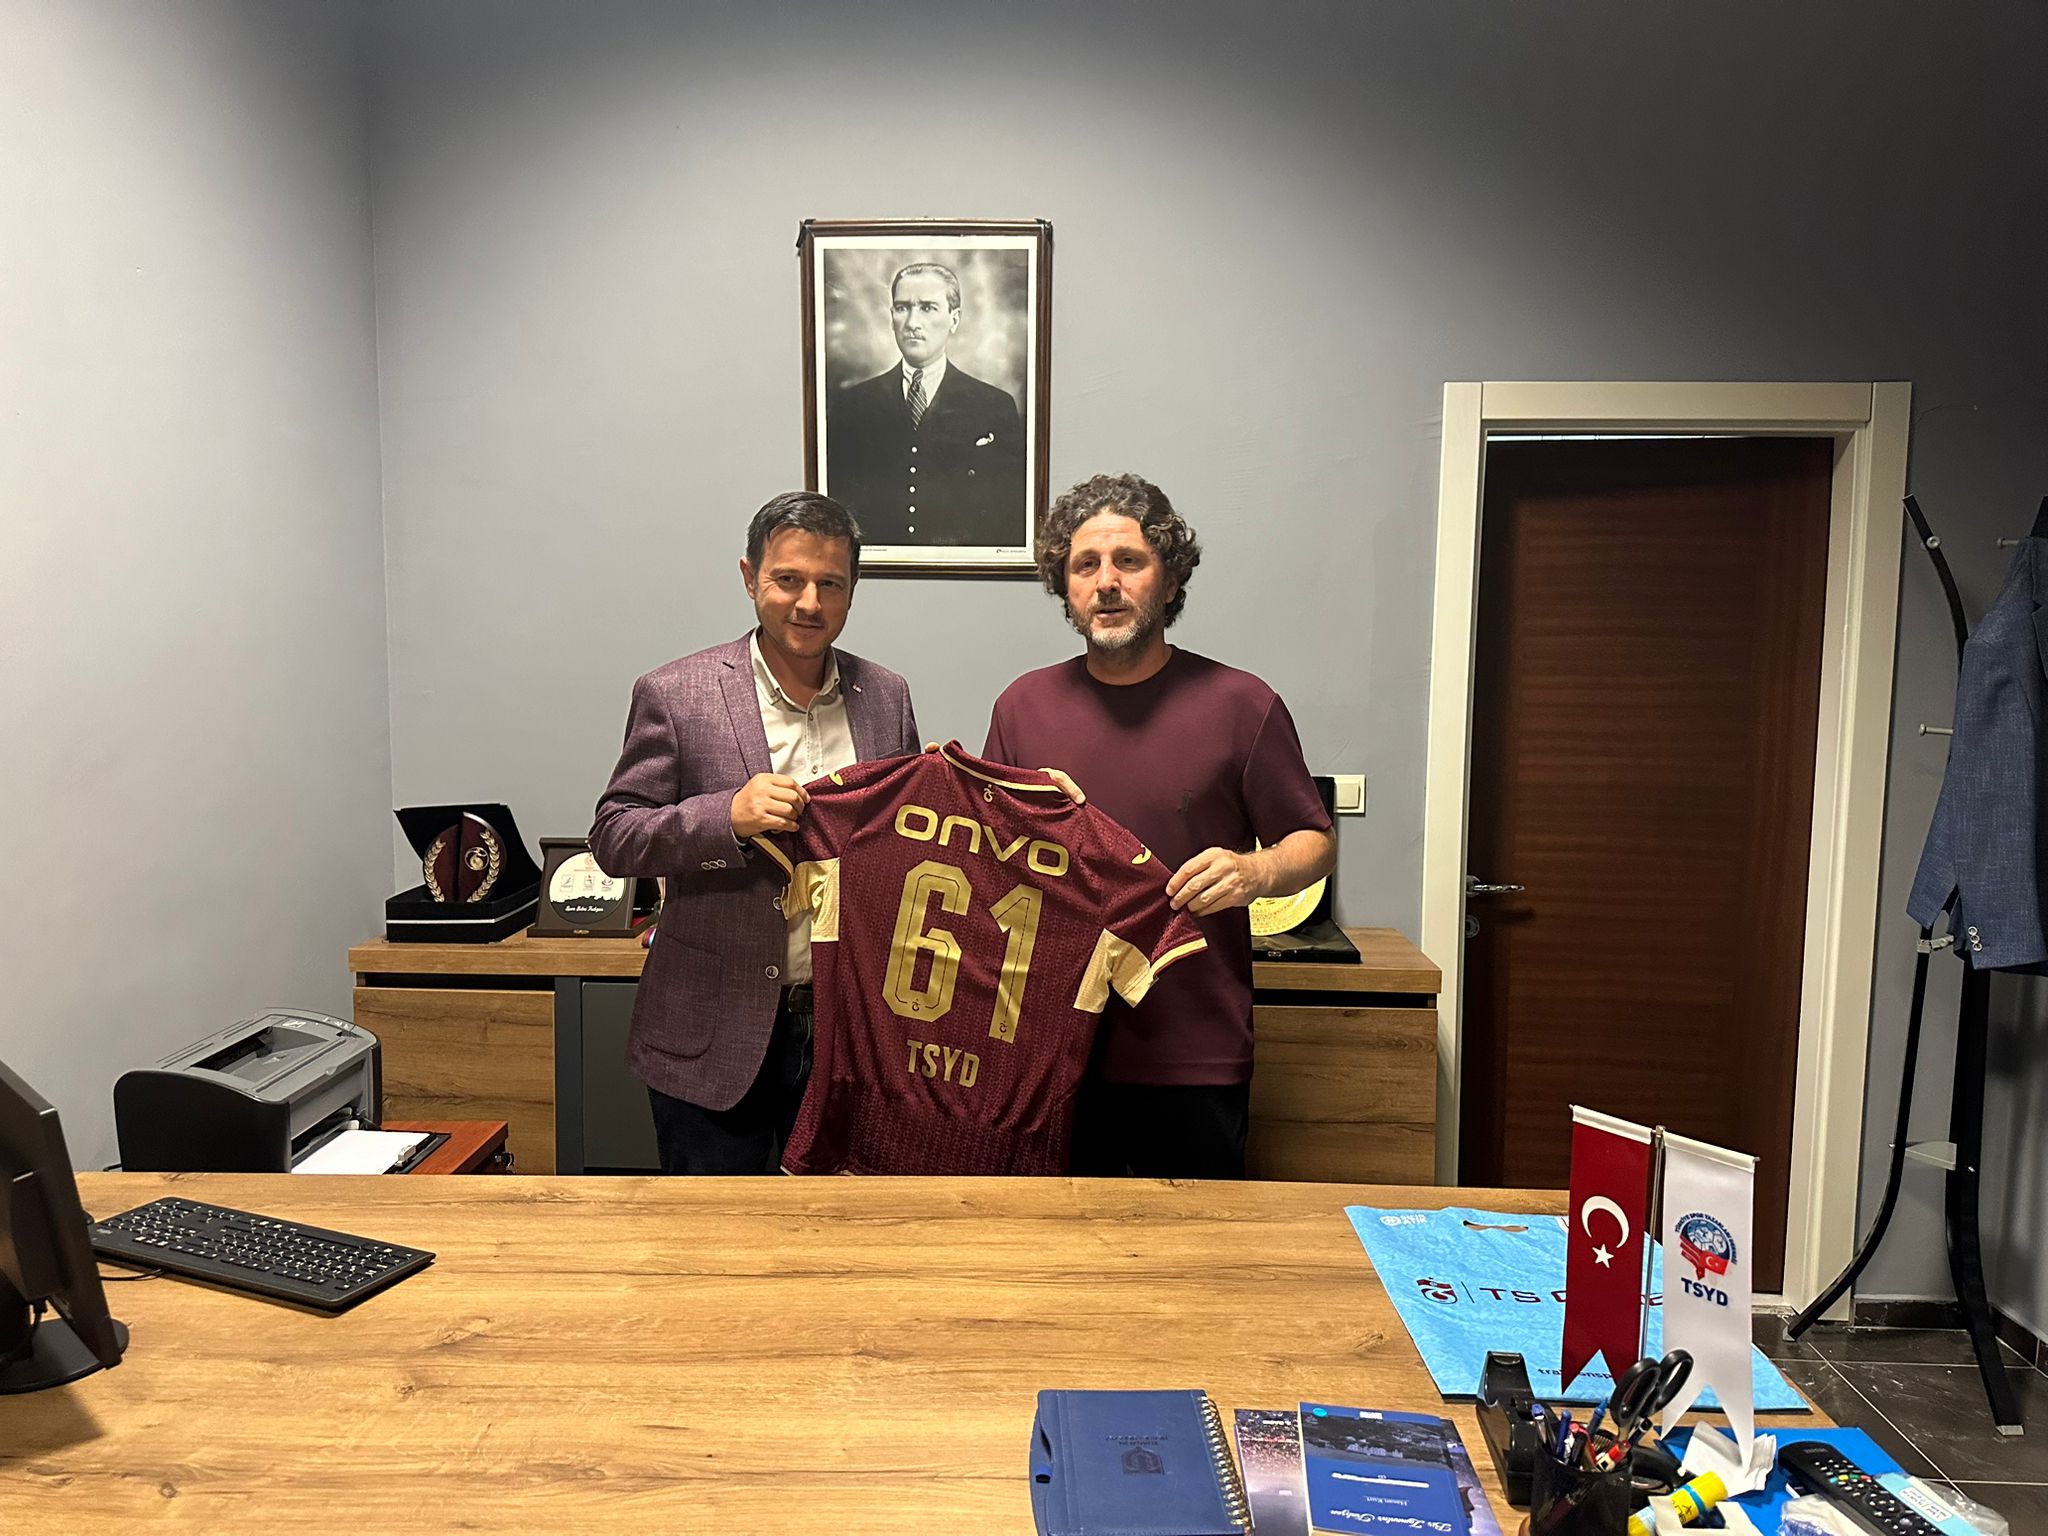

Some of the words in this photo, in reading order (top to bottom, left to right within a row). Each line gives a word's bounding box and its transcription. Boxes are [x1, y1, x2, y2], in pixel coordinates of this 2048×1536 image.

[882, 859, 1043, 1044] 61
[907, 1040, 980, 1088] TSYD
[1479, 1287, 1541, 1303] TS
[1681, 1277, 1728, 1306] TSYD
[1377, 1515, 1425, 1529] Zamanlar
[1427, 1521, 1452, 1533] Bir
